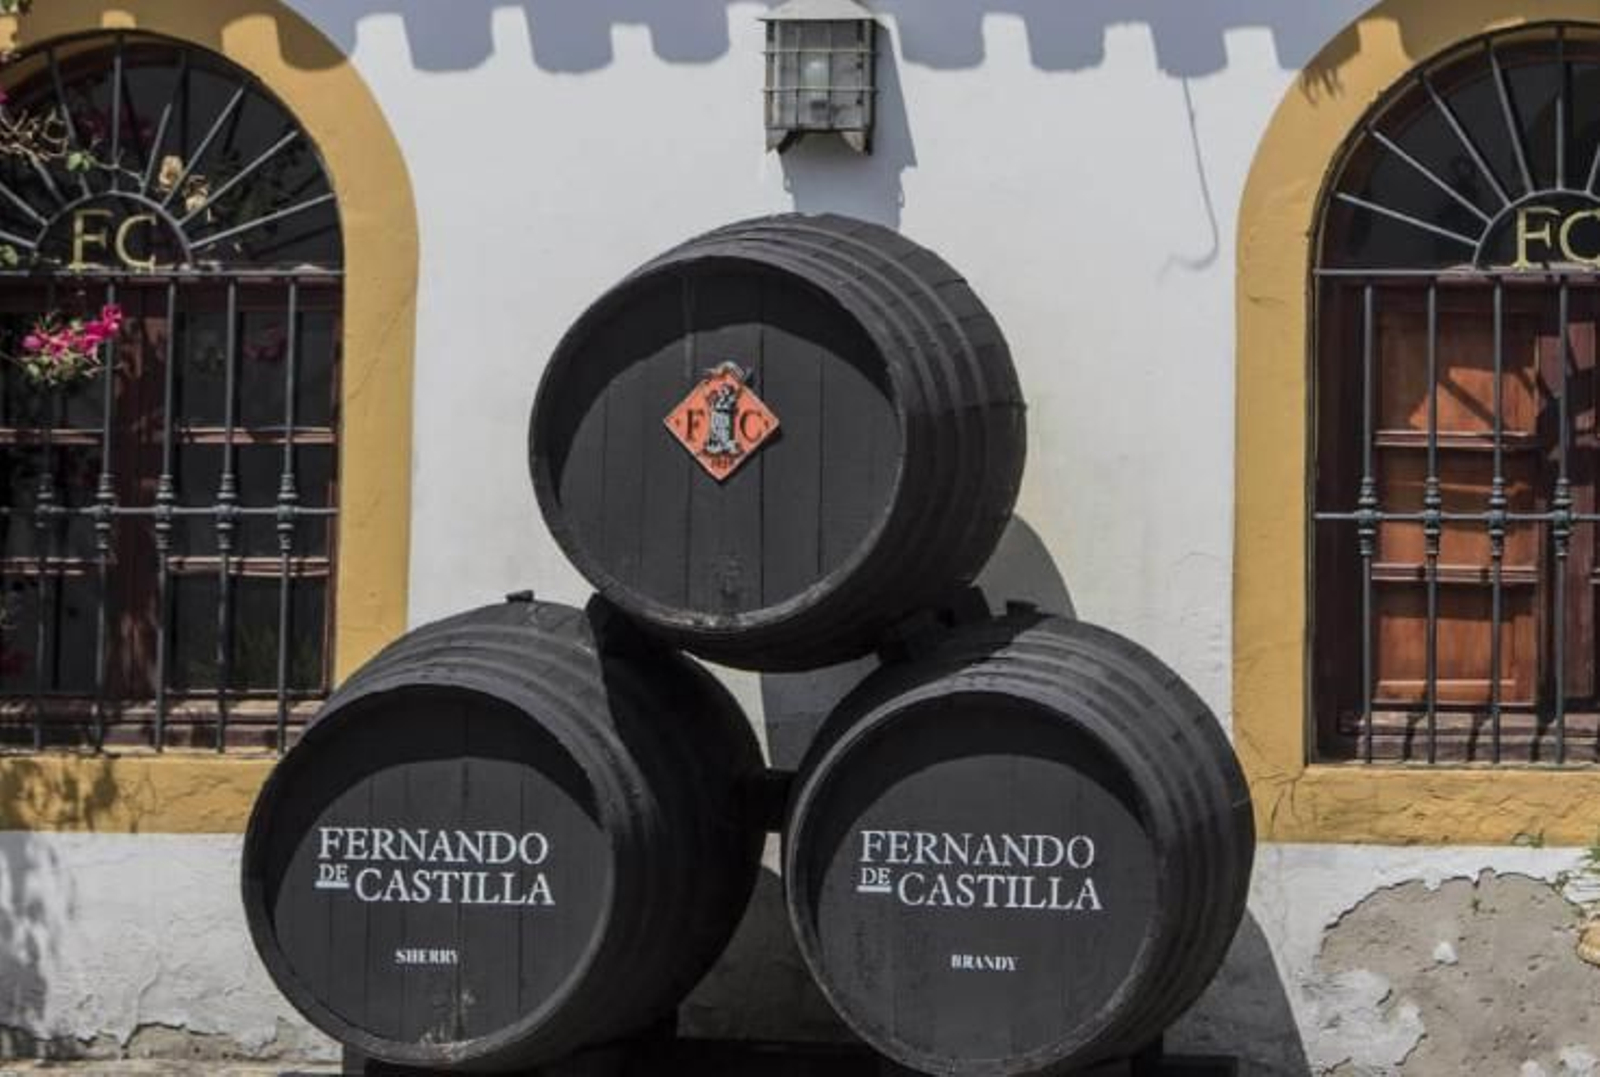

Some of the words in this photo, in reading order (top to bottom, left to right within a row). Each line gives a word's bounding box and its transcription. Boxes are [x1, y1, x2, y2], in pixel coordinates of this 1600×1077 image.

[69, 208, 157, 273] FC
[318, 827, 549, 864] FERNANDO
[859, 830, 1096, 869] FERNANDO
[318, 863, 349, 883] DE
[355, 868, 556, 905] CASTILLA
[860, 867, 891, 886] DE
[898, 872, 1103, 910] CASTILLA
[951, 954, 1018, 971] BRANDY
